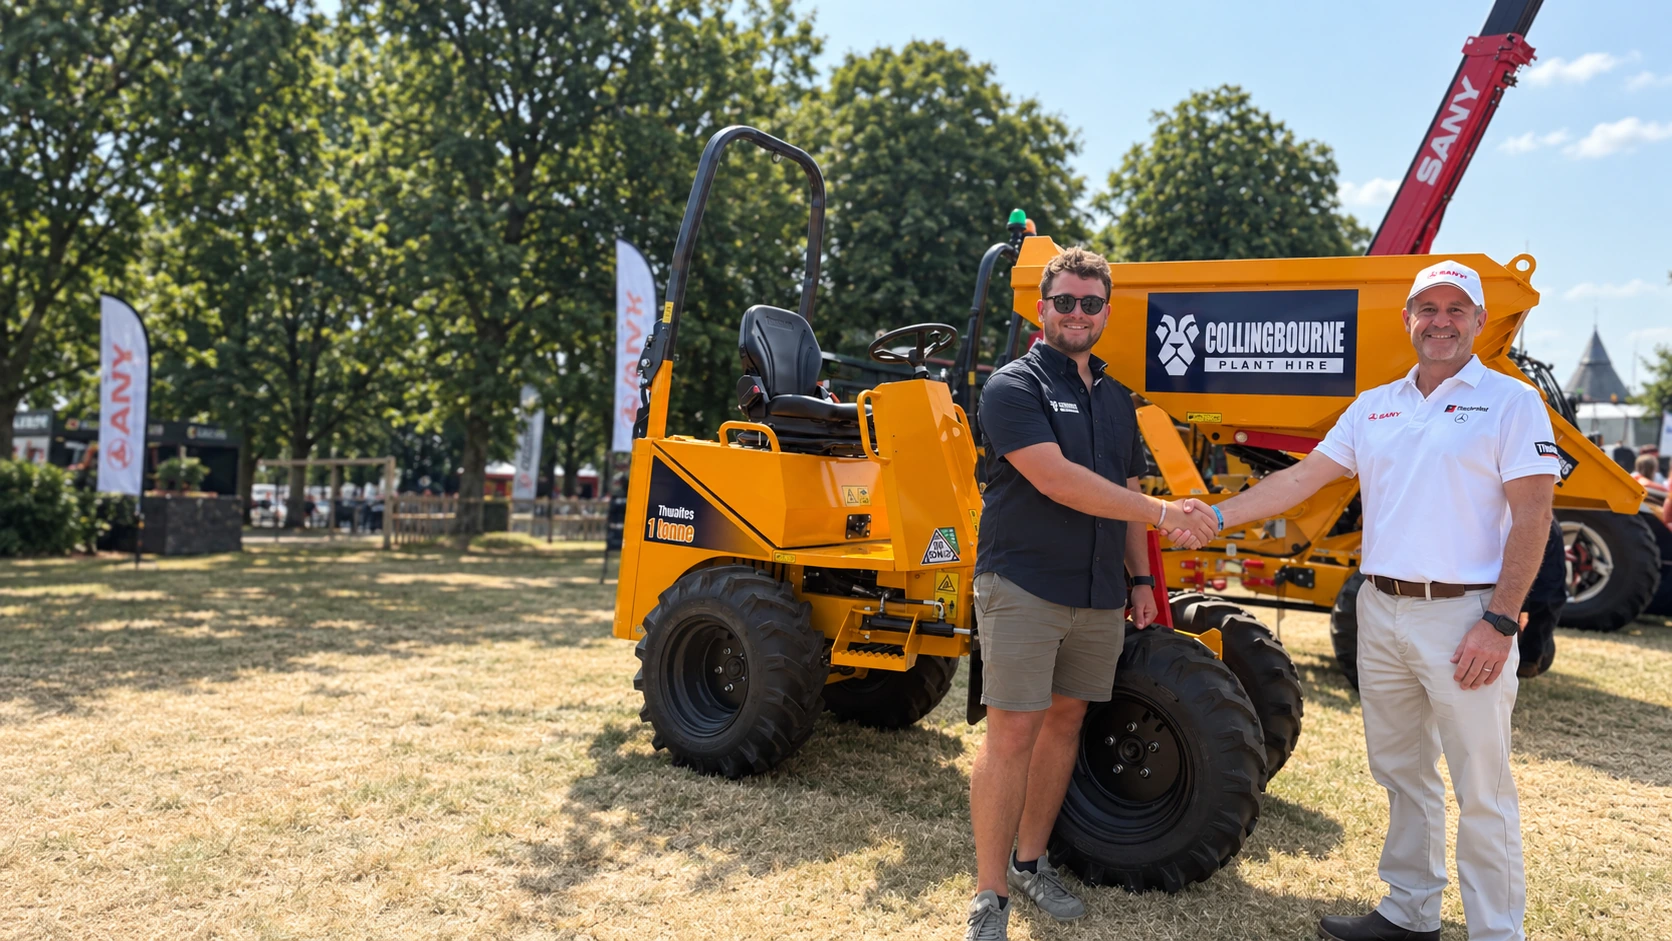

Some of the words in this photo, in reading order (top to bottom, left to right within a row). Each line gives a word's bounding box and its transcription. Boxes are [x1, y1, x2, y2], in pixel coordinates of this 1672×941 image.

[1416, 75, 1480, 186] SANY
[1205, 321, 1345, 354] COLLINGBOURNE
[1218, 360, 1274, 370] PLANT
[1285, 360, 1328, 370] HIRE
[658, 504, 695, 520] Thwaites
[648, 517, 655, 538] 1
[656, 518, 695, 543] tonne
